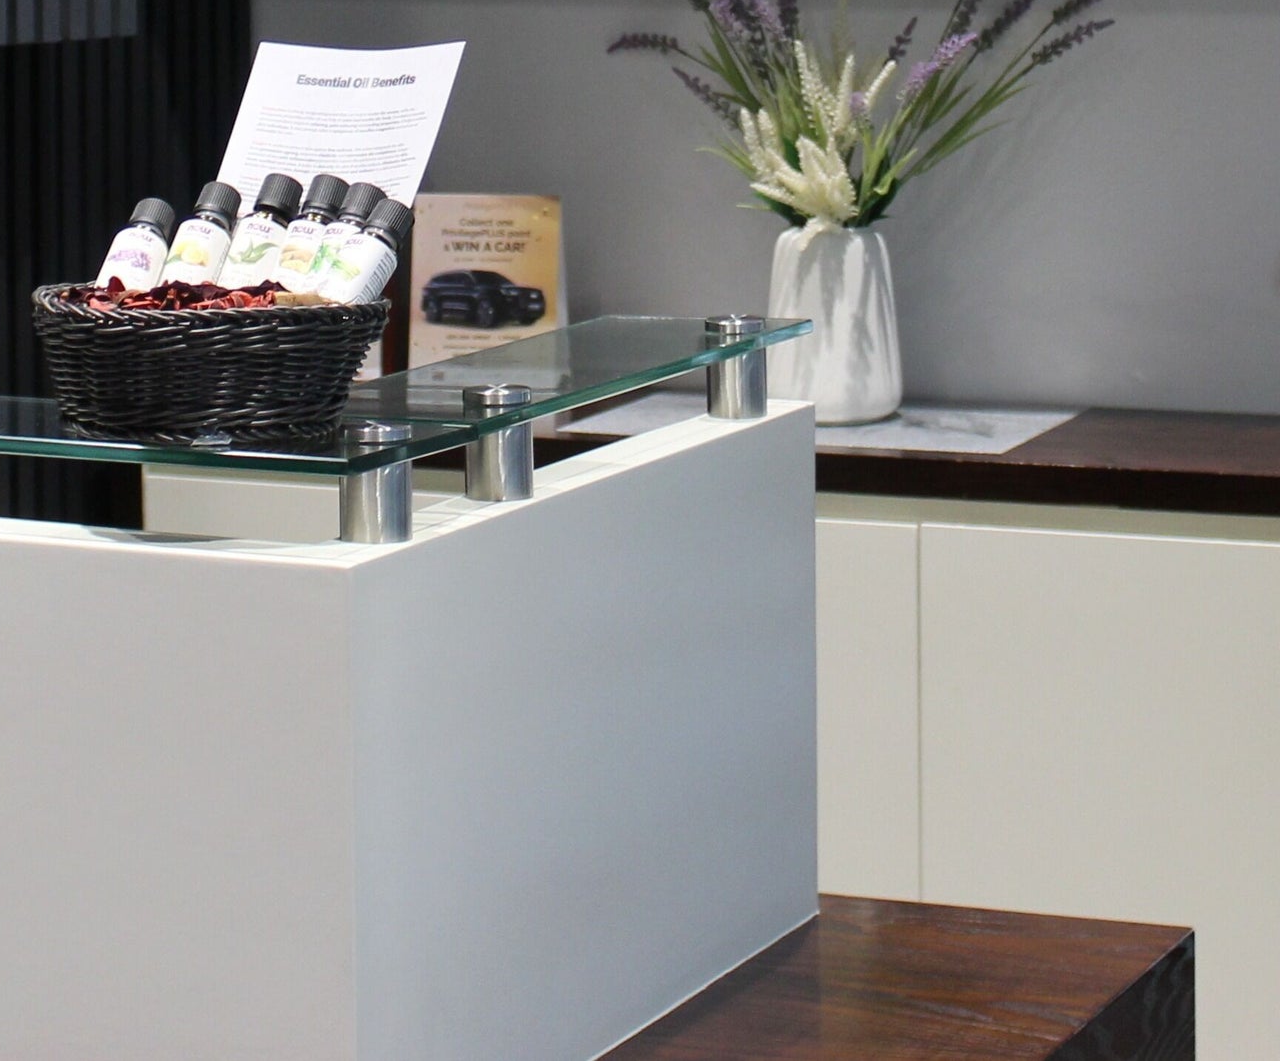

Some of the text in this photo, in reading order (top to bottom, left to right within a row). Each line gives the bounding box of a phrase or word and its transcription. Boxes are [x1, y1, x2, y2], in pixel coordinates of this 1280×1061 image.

[296, 74, 416, 88] Essential Oil Benefits
[452, 242, 480, 252] WIN
[483, 242, 492, 252] A
